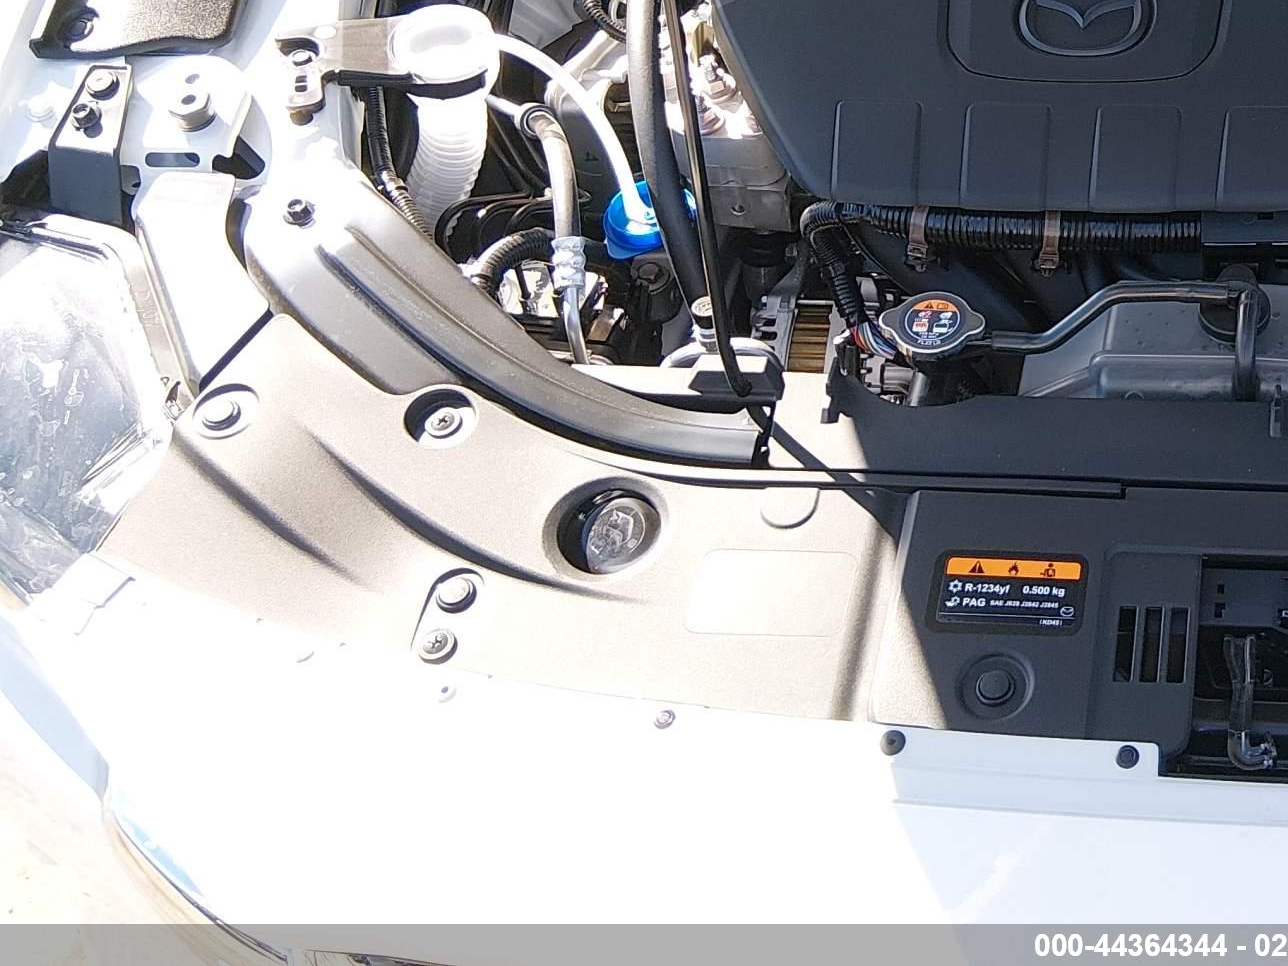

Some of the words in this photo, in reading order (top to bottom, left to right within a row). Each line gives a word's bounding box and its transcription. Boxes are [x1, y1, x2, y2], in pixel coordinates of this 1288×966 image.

[964, 583, 1011, 595] R-1234yf
[1022, 585, 1050, 595] 0.500
[1052, 586, 1066, 597] kg
[962, 597, 986, 607] PAG
[990, 599, 1004, 607] SAE
